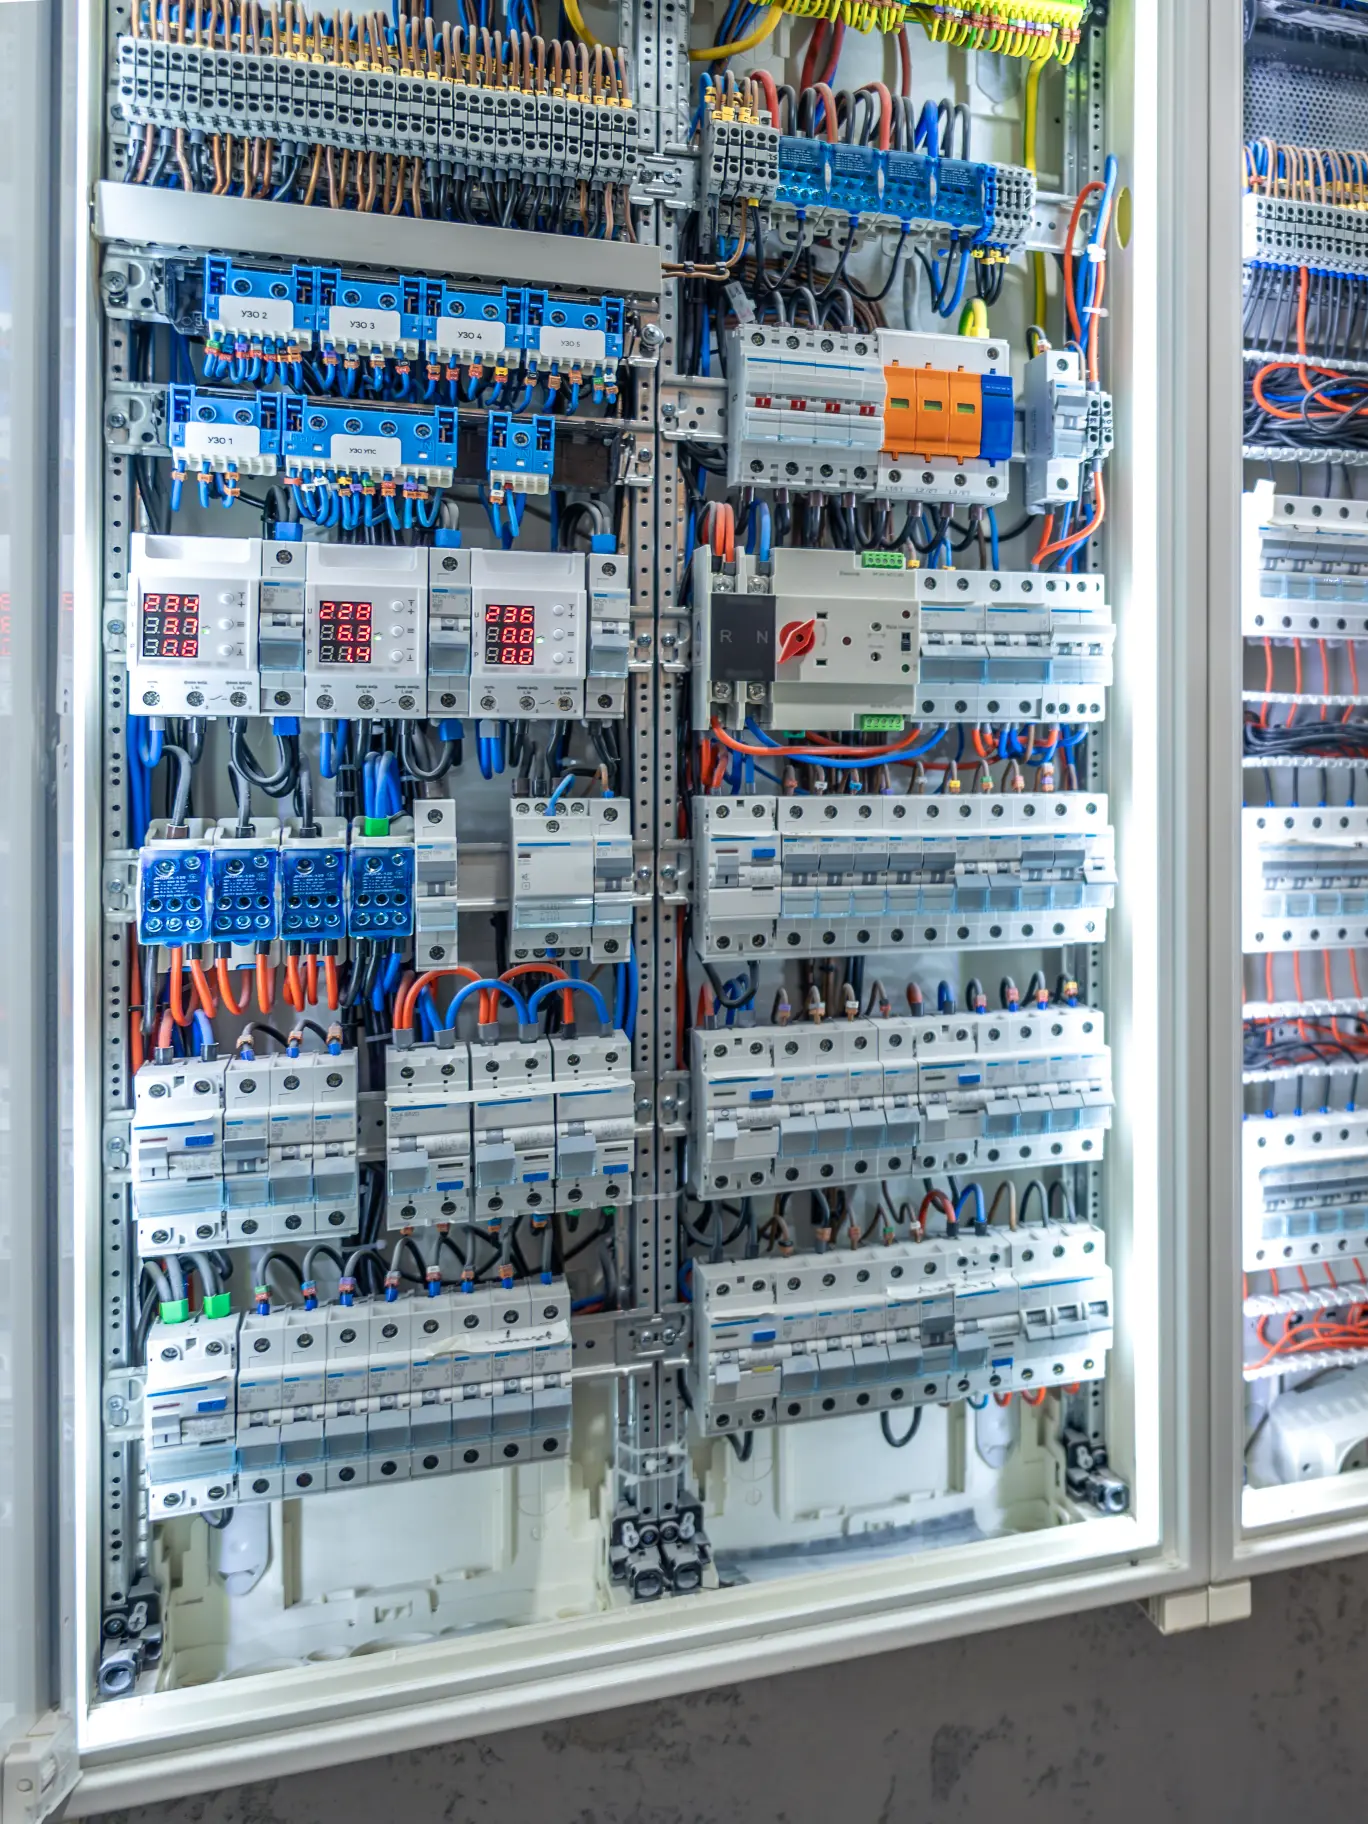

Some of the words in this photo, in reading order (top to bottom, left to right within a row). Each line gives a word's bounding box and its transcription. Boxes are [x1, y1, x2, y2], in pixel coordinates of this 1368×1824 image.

[241, 310, 260, 319] УЗО
[262, 312, 268, 320] 2
[350, 320, 368, 330] УЗО
[370, 322, 375, 330] 3
[458, 331, 474, 340] УЗО
[560, 340, 574, 348] УЗО
[208, 436, 226, 444] УЗО
[144, 594, 198, 612] 234
[320, 602, 370, 620] 228
[486, 606, 533, 622] 236
[164, 617, 198, 635] 3.7
[338, 624, 370, 642] 6.3
[502, 627, 534, 644] 0.0
[720, 630, 732, 643] R
[757, 631, 768, 644] N
[162, 638, 198, 656] 0.8
[346, 647, 370, 662] 1.4
[501, 647, 532, 664] 0.0
